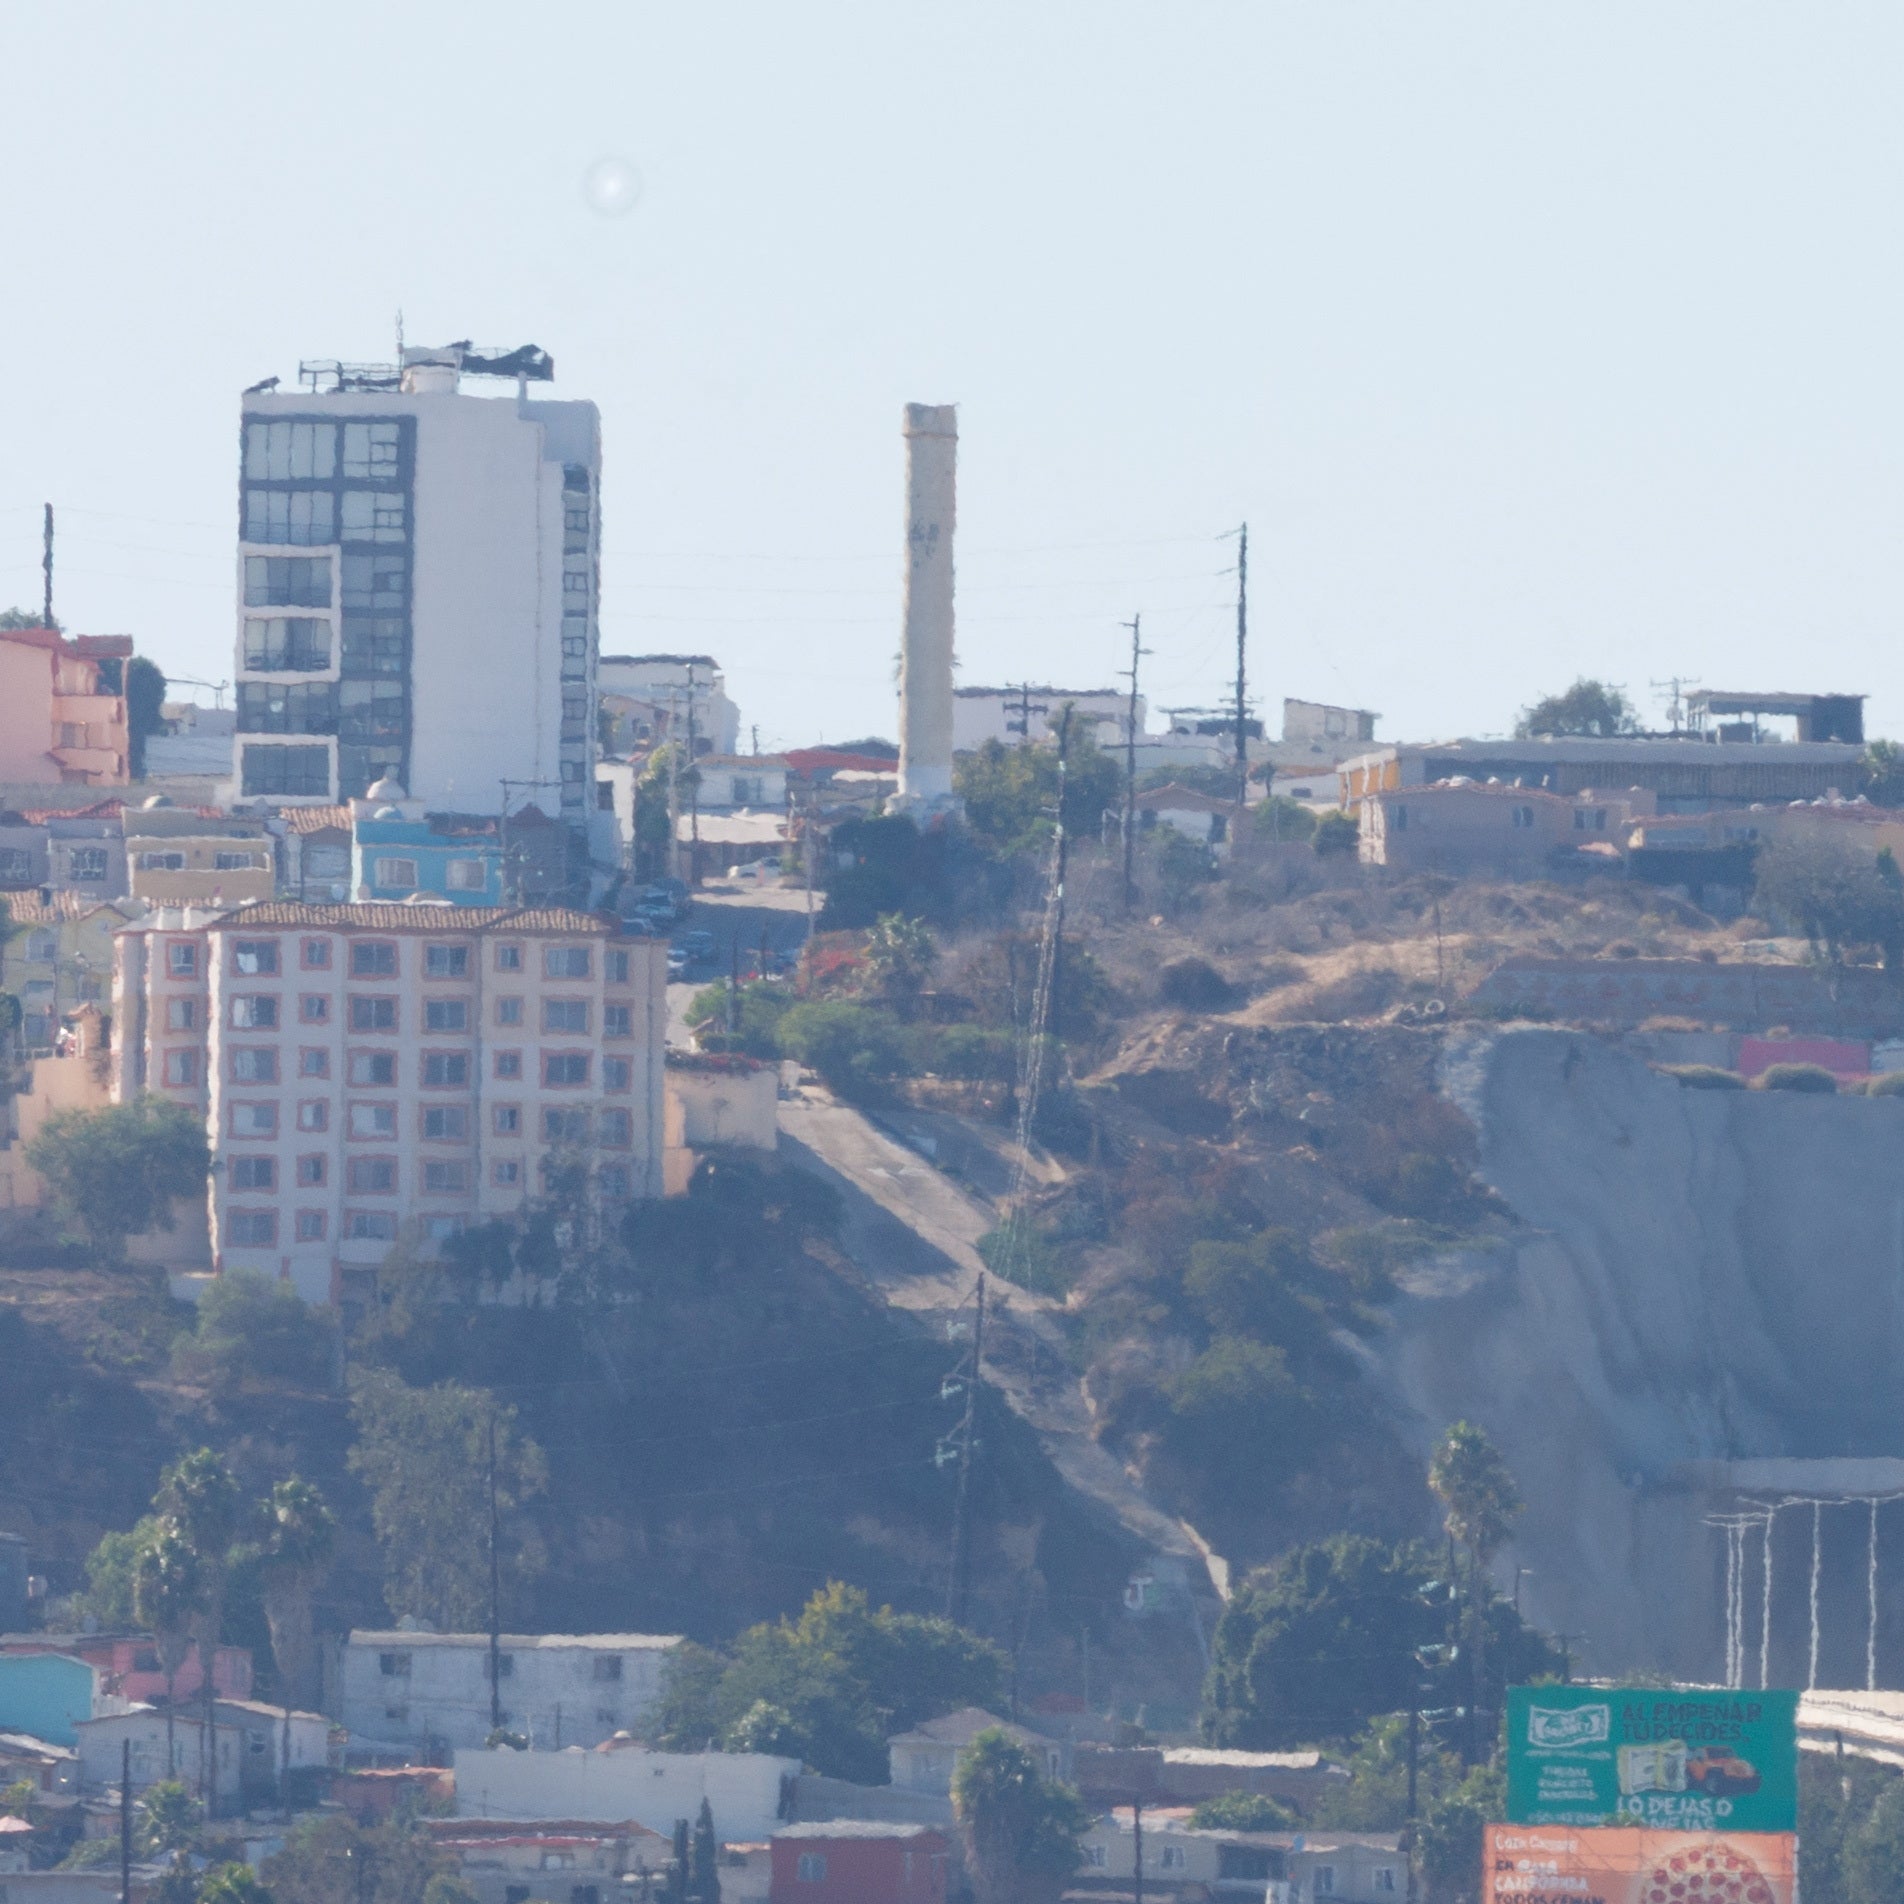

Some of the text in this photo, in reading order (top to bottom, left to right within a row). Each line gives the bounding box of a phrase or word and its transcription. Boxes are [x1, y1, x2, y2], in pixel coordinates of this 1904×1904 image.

[1622, 1723, 1649, 1741] TU
[1648, 1796, 1712, 1817] DEJAS
[1716, 1799, 1734, 1817] O
